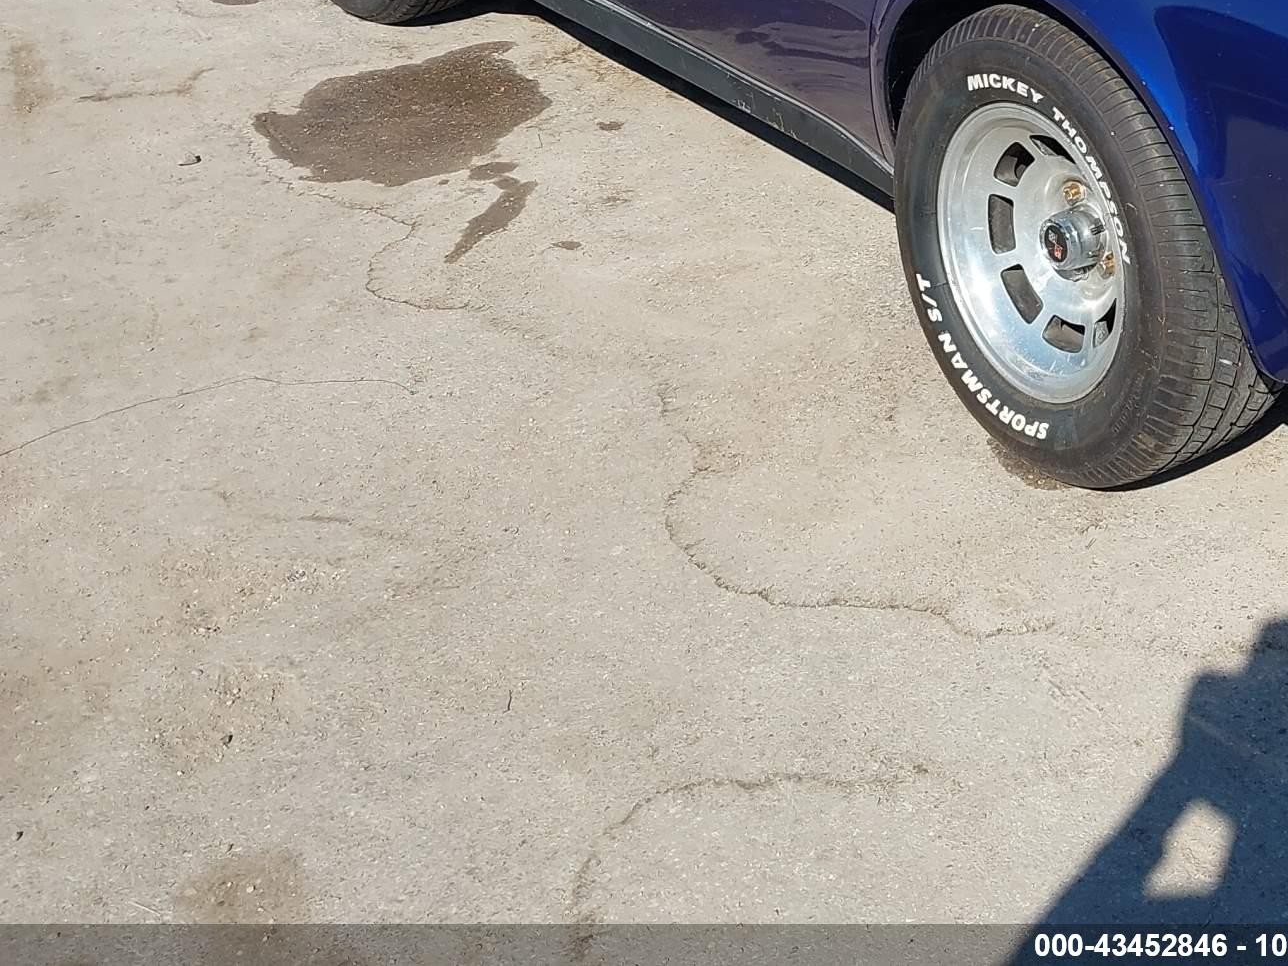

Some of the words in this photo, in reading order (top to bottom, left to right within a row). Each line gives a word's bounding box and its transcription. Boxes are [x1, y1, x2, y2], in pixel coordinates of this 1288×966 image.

[967, 73, 1044, 105] MICKEY
[1051, 105, 1131, 265] THOMPSON
[916, 273, 942, 324] S/T
[938, 329, 1049, 440] SPORTSMAN
